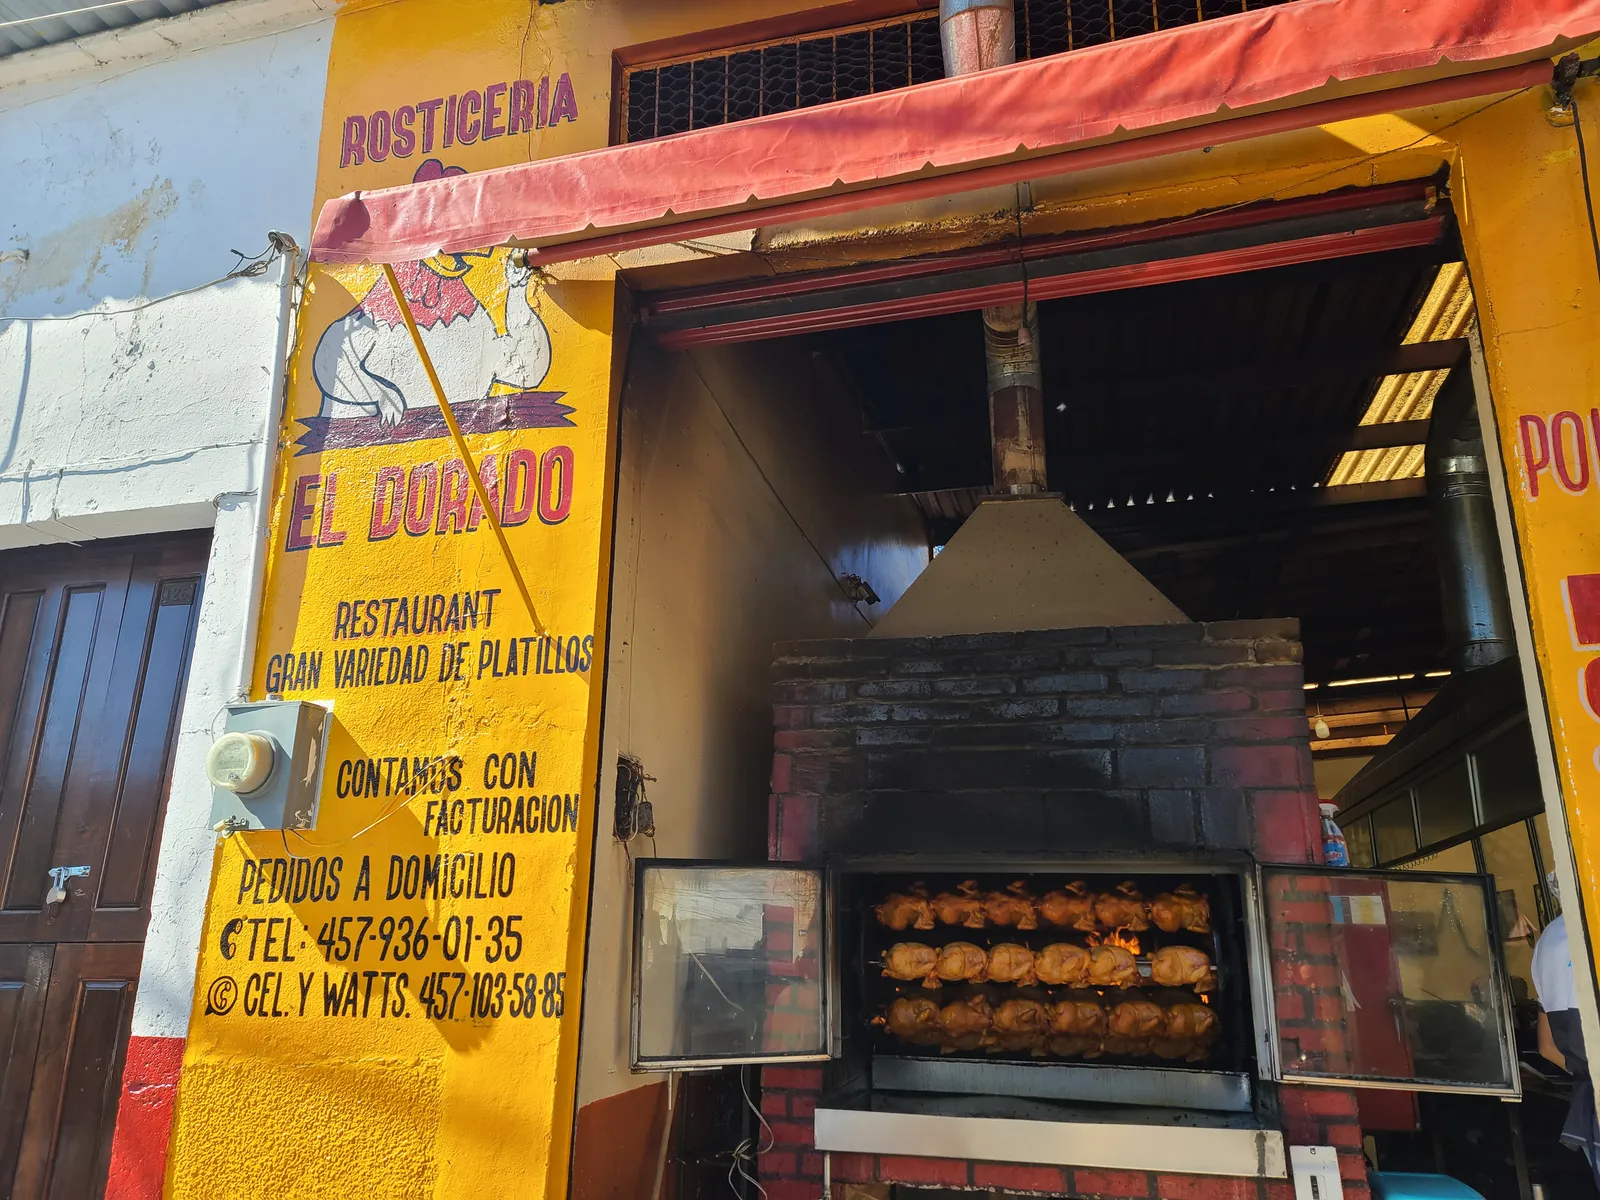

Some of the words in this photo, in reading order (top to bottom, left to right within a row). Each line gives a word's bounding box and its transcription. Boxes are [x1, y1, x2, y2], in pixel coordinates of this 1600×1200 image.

[340, 72, 578, 168] ROSTICERIA
[285, 471, 347, 552] EL
[368, 445, 575, 542] DORADO
[332, 588, 501, 641] RESTAURANT
[265, 651, 322, 693] GRAN
[334, 644, 429, 689] VARIEDAD
[439, 641, 470, 683] DE
[477, 634, 594, 680] PLATILLOS
[336, 755, 464, 799] CONTAMOS
[483, 751, 537, 790] CON
[423, 793, 580, 836] FACTURACION
[237, 855, 343, 905] PEDIDOS
[353, 855, 370, 901] A
[386, 852, 516, 901] DOMICILIO
[247, 917, 309, 963] TEL:
[317, 915, 523, 963] 457-936-01-35
[243, 972, 290, 1018] CEL.
[298, 972, 314, 1018] Y
[323, 971, 410, 1019] WATTS.
